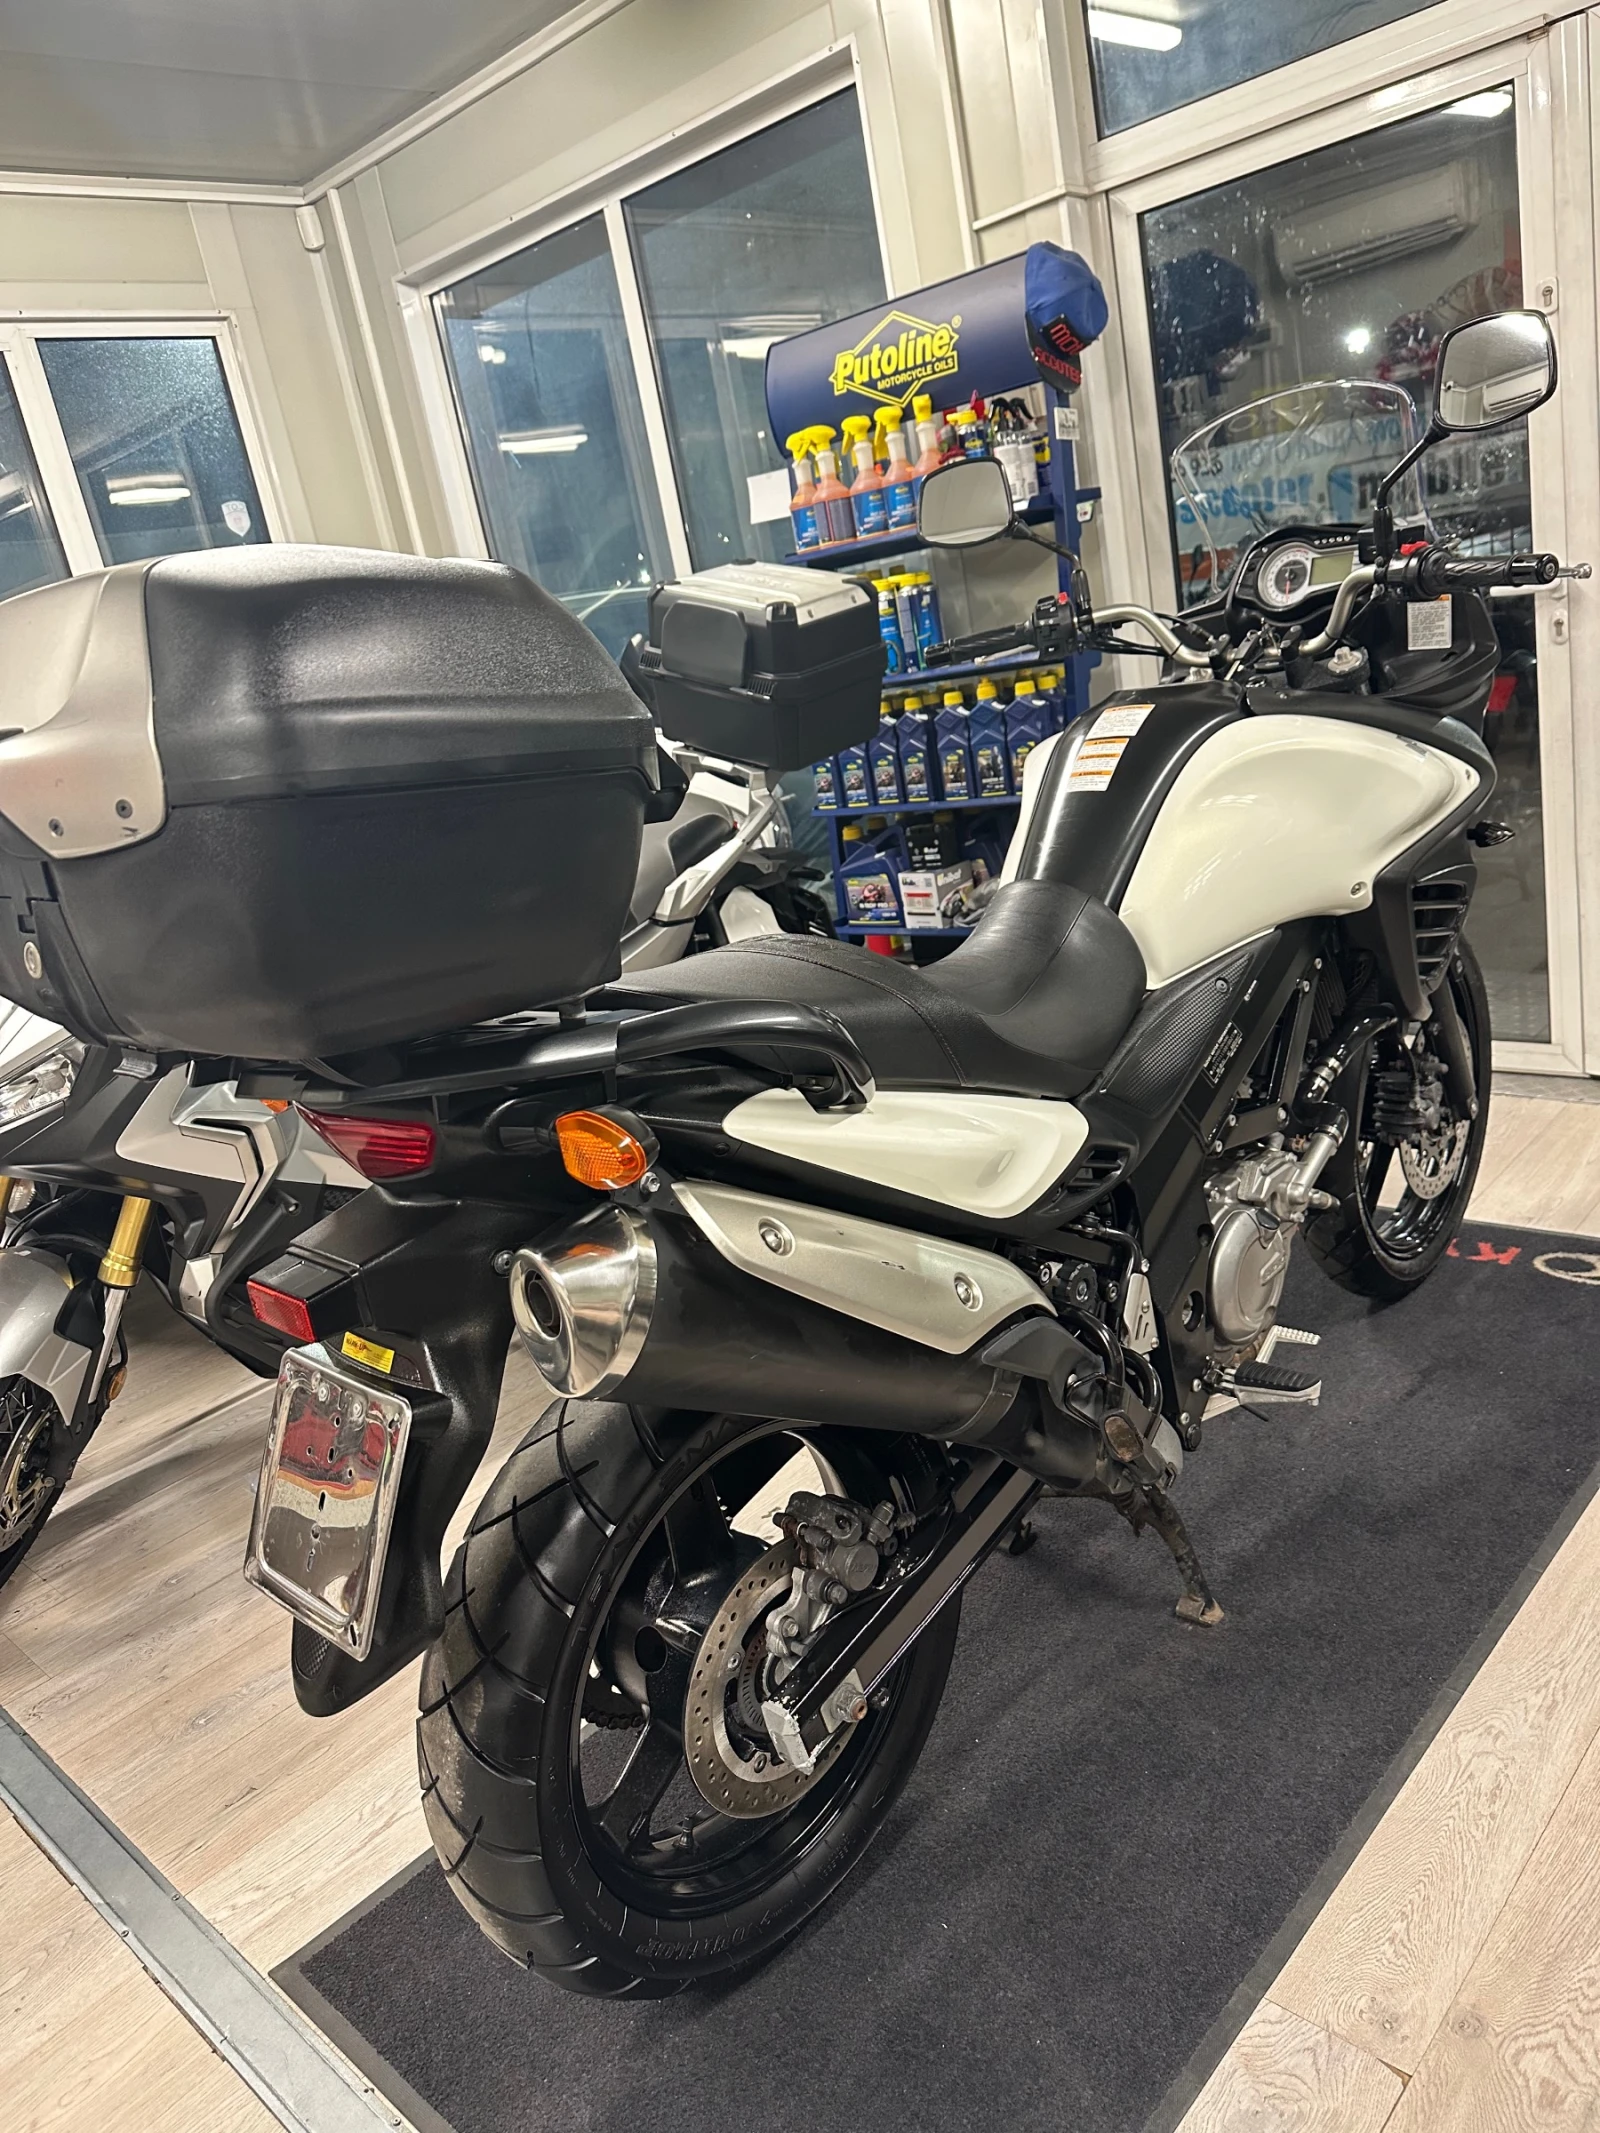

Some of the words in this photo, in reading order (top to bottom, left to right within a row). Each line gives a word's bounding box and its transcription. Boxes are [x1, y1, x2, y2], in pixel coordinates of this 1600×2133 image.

[836, 327, 951, 391] Putoline
[877, 364, 932, 390] MOTORCYCLE
[933, 356, 954, 371] OILS
